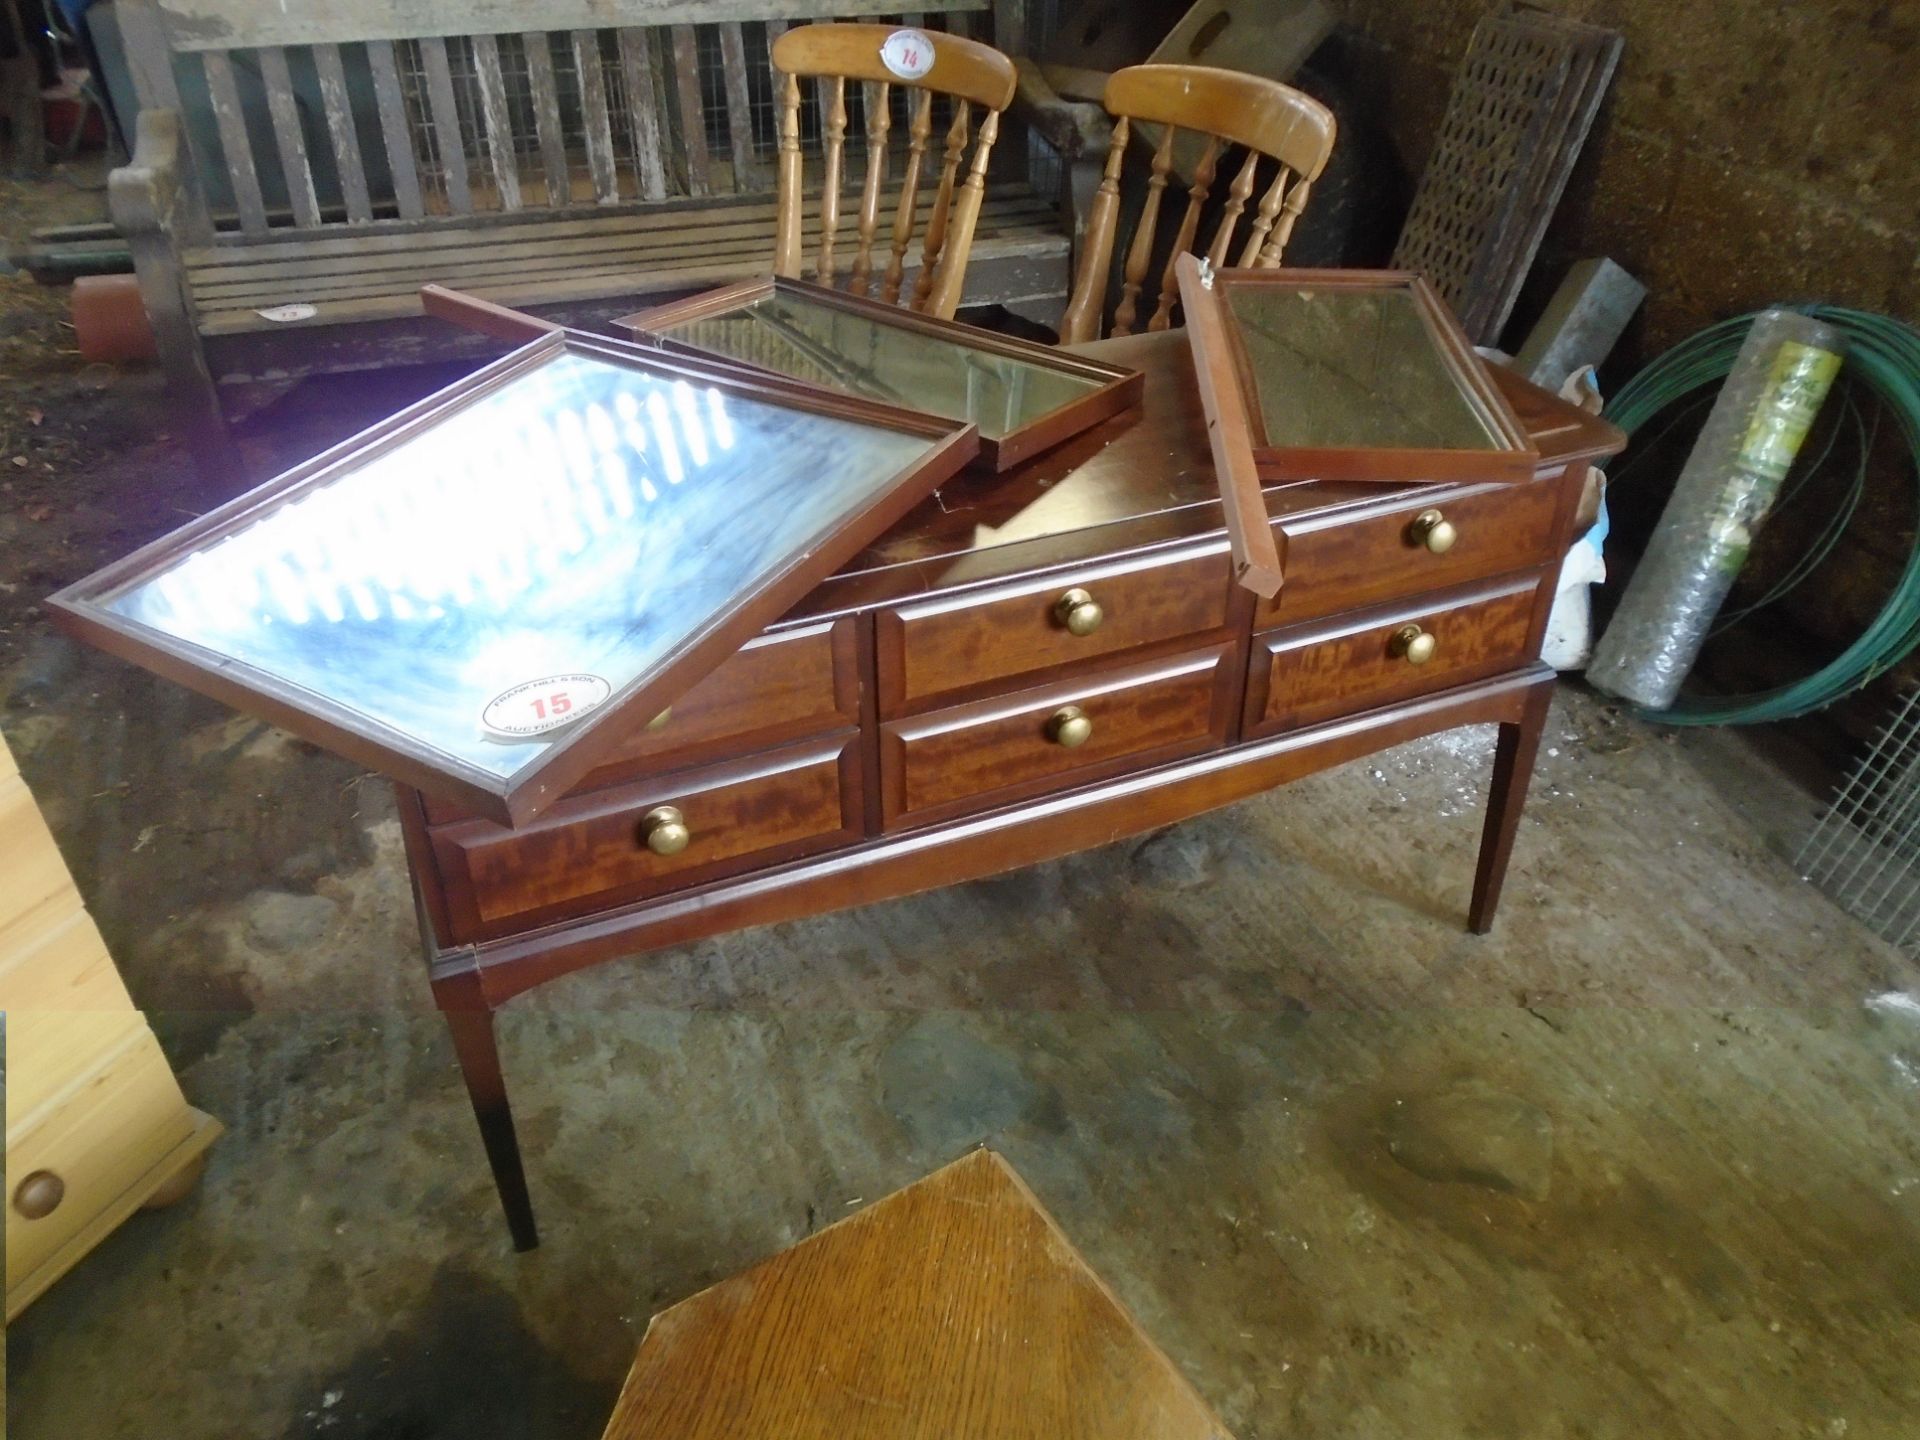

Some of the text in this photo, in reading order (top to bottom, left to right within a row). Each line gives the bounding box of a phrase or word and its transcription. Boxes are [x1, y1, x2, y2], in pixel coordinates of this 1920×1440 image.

[902, 48, 917, 68] 14
[494, 684, 530, 707] FRANK
[533, 679, 556, 688] HILL
[571, 676, 596, 684] SON
[530, 692, 572, 719] 15
